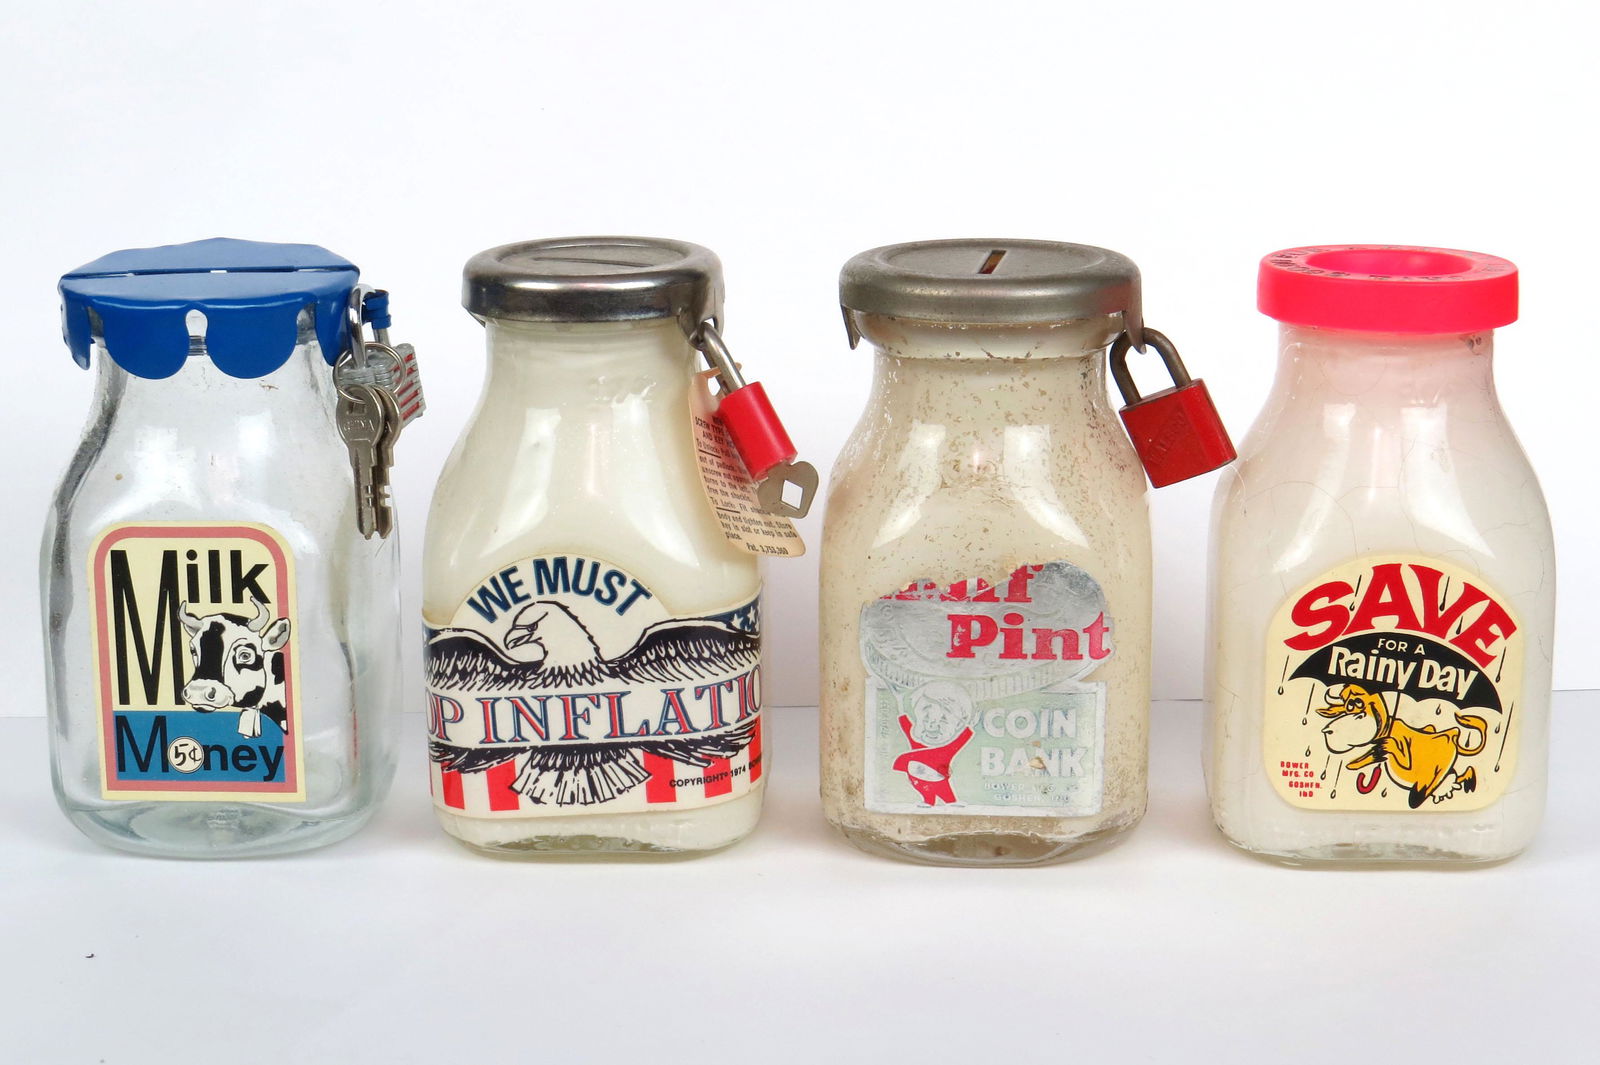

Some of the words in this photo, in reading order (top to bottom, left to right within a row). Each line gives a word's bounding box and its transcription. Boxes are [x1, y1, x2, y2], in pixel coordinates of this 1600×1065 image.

[467, 565, 532, 624] WE
[532, 556, 653, 616] MUST
[110, 549, 272, 706] Milk
[946, 611, 1111, 661] Pint
[1283, 563, 1517, 669] SAVE
[1377, 638, 1408, 653] FOR
[1414, 643, 1426, 656] A
[1327, 646, 1417, 691] Rainy
[1418, 659, 1479, 701] Day
[982, 707, 1078, 739] COIN
[730, 765, 746, 778] 1974
[980, 745, 1088, 777] BANK
